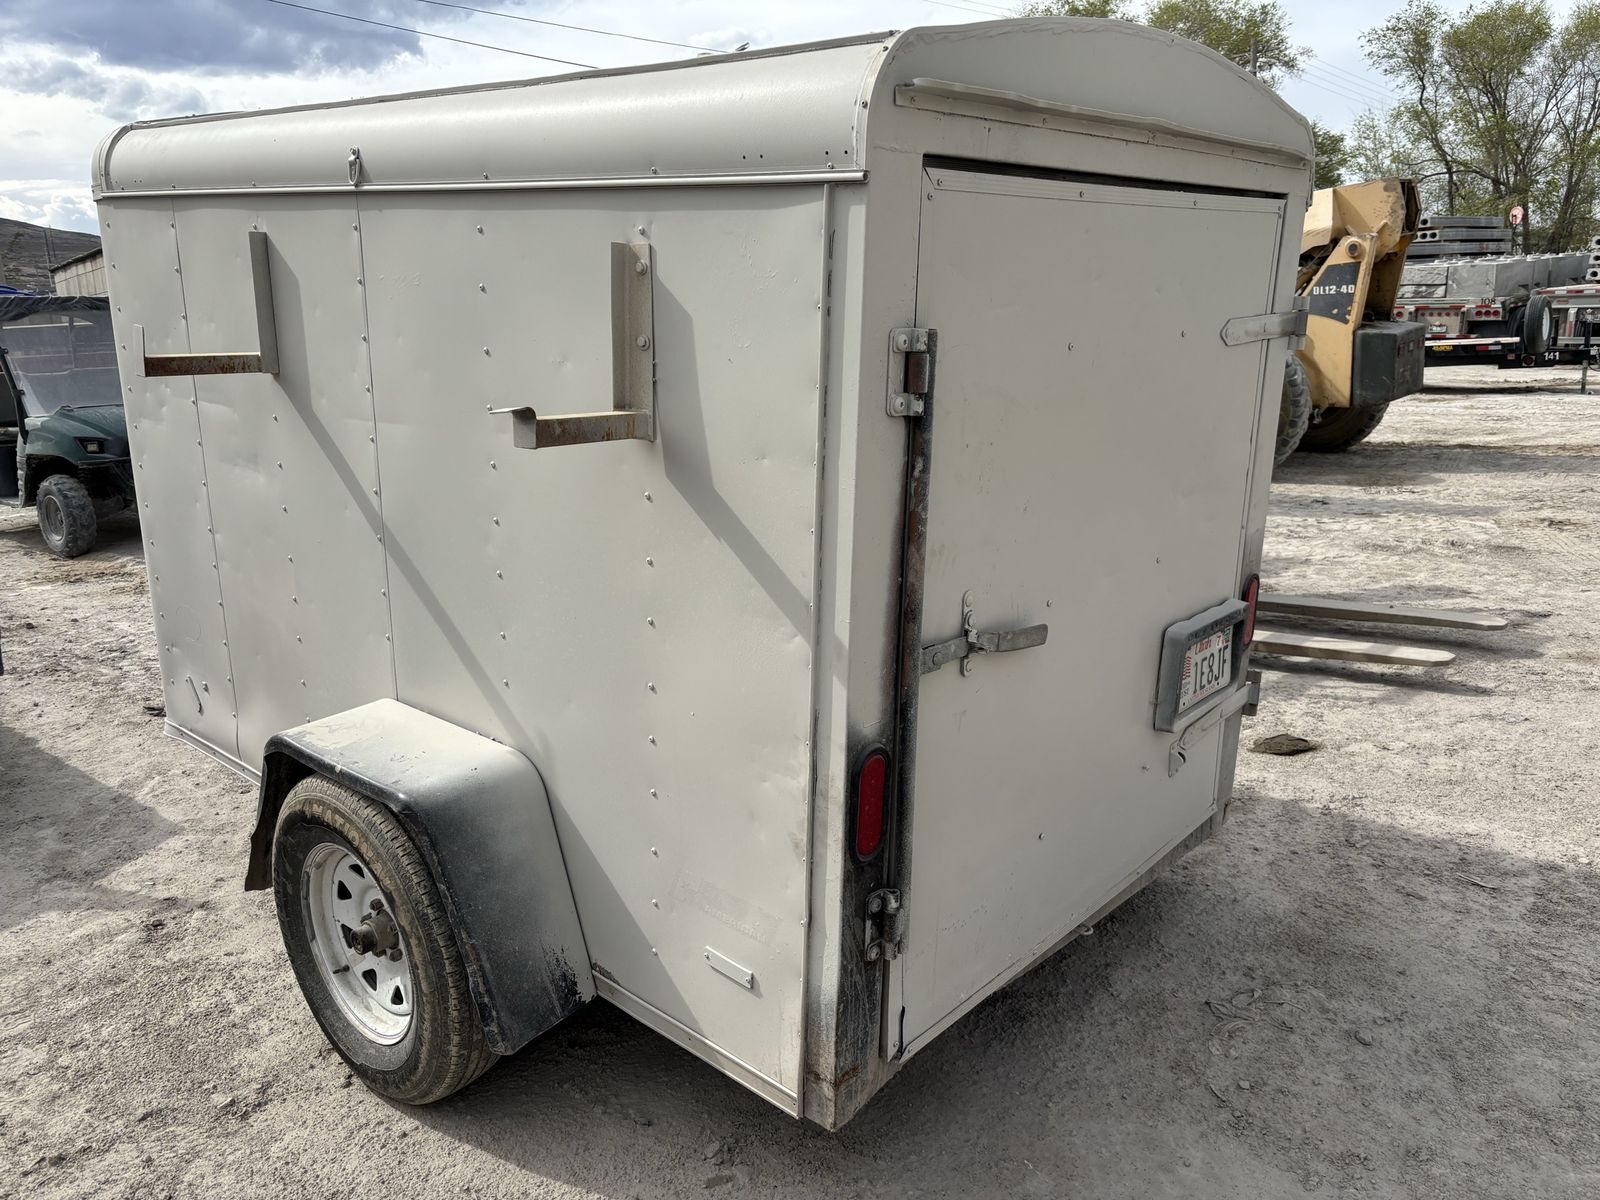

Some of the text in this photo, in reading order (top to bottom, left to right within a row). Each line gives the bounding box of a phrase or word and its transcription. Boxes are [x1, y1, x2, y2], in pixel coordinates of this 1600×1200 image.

[1481, 297, 1496, 305] 108
[1544, 351, 1560, 360] 141
[1193, 644, 1229, 694] 1E8JF
